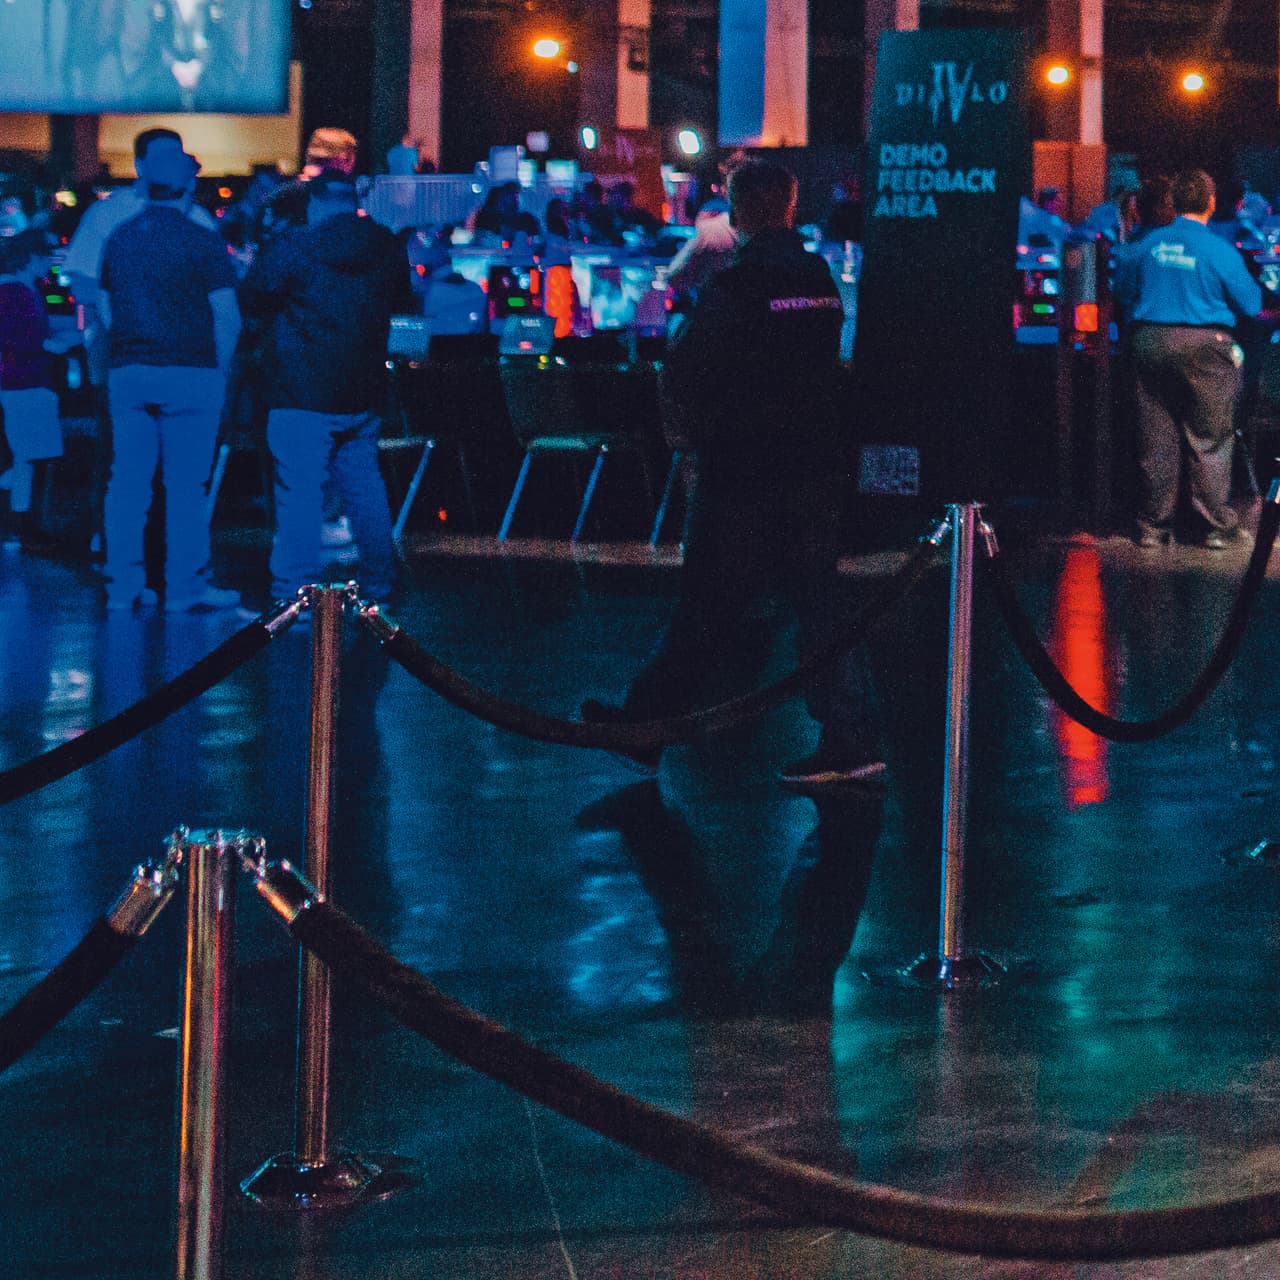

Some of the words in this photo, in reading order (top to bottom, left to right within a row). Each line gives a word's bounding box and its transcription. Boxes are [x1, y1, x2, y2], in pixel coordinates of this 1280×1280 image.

[880, 142, 948, 167] DEMO
[878, 168, 996, 193] FEEDBACK
[873, 194, 938, 218] AREA
